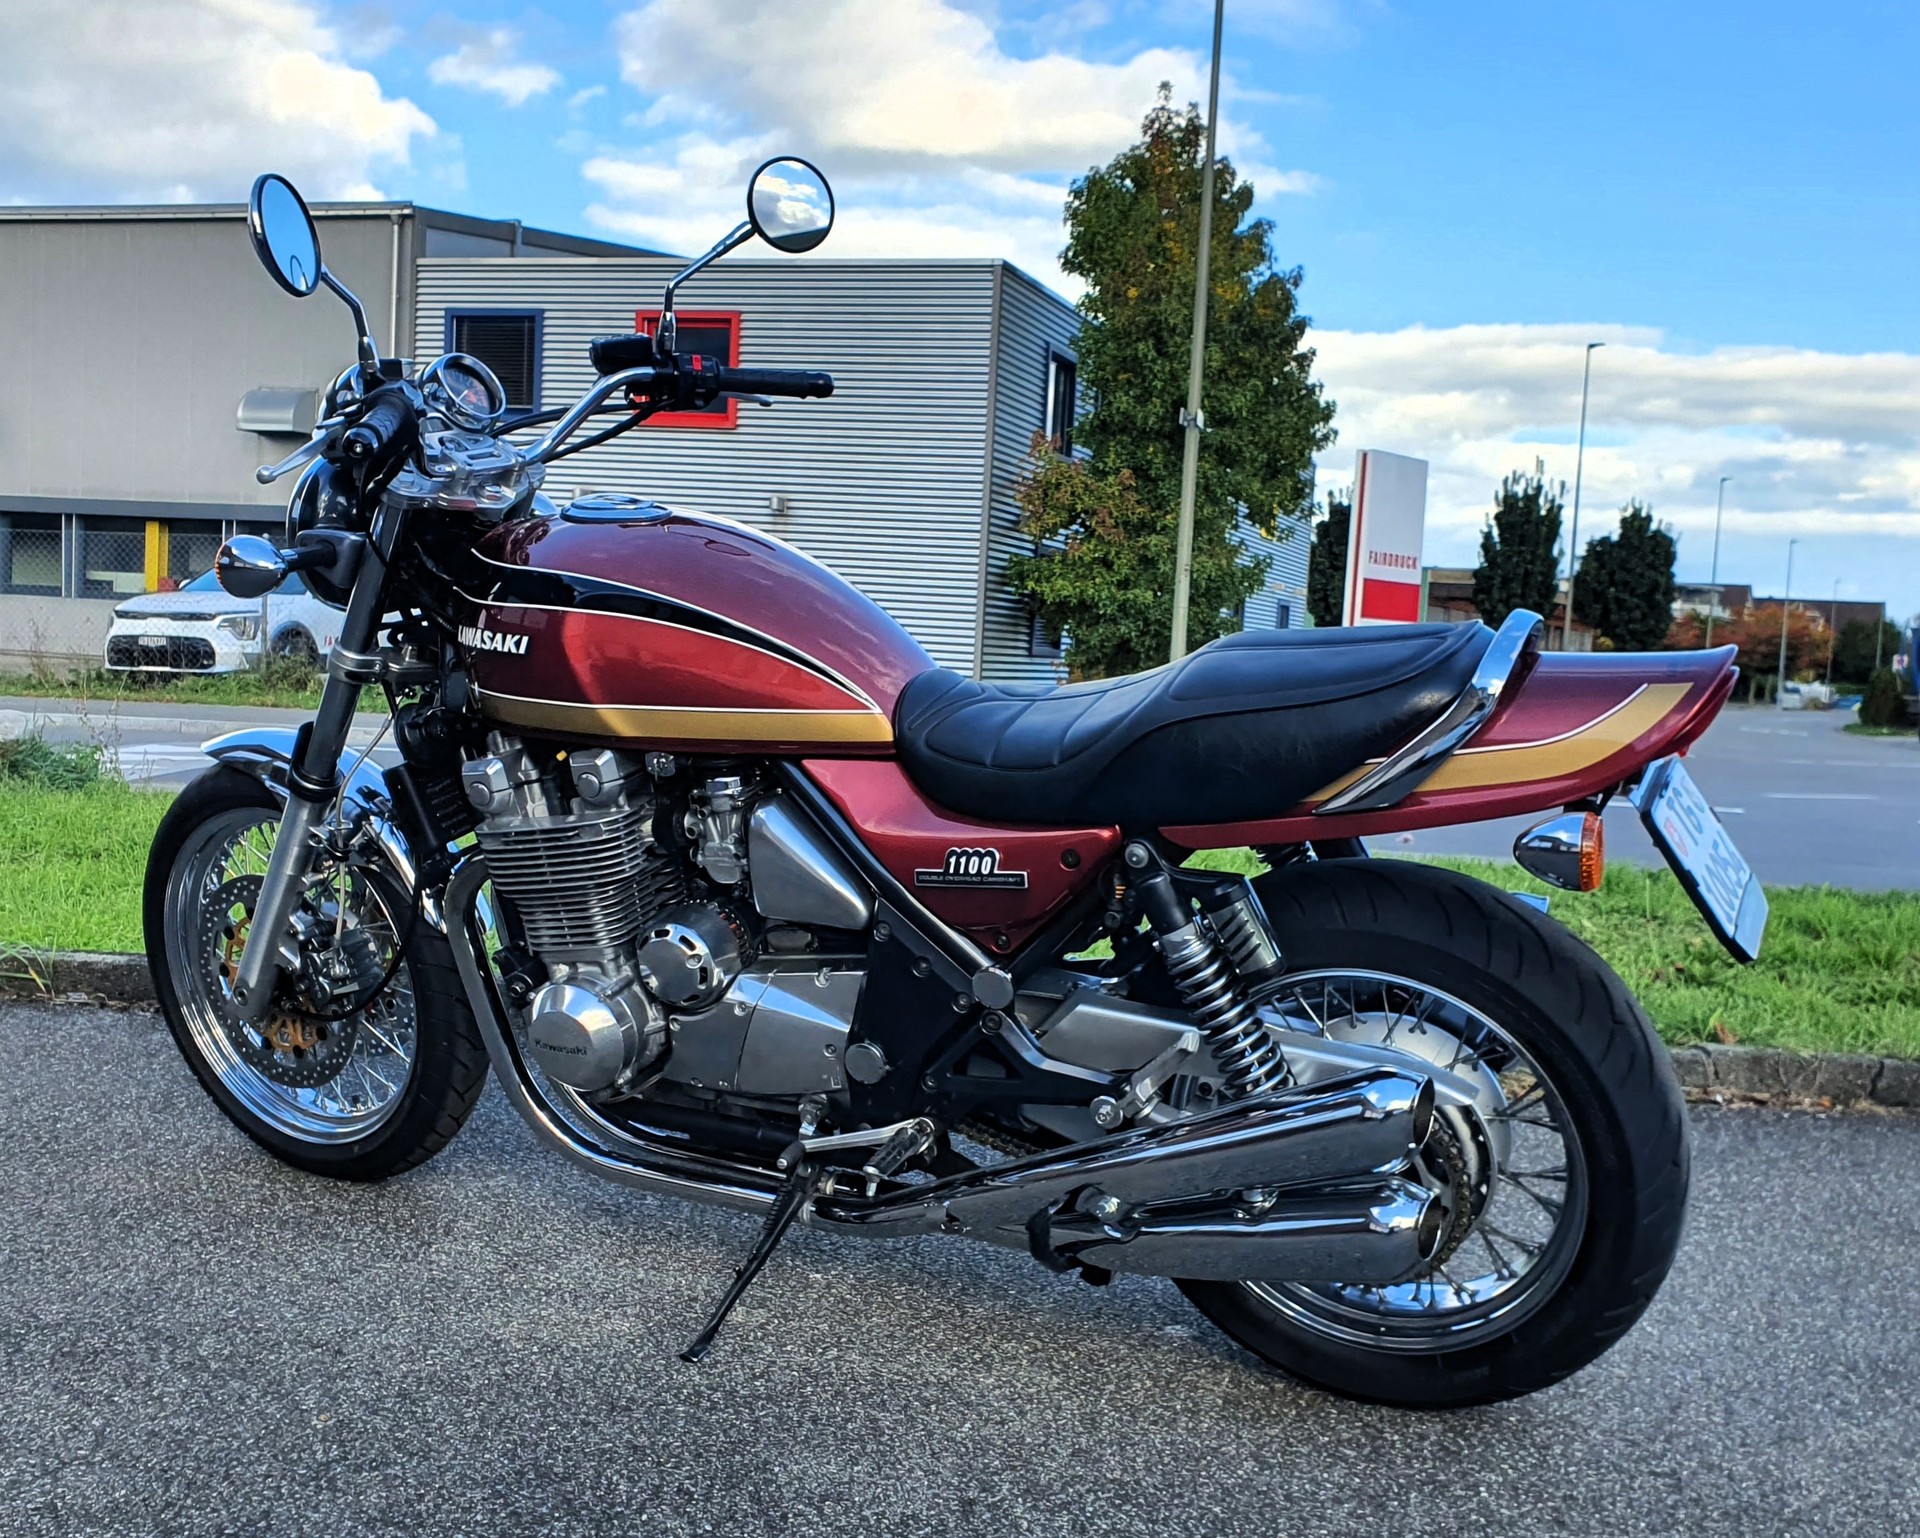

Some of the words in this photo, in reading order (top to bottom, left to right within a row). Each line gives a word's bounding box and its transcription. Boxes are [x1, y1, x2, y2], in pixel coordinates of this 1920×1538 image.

[1368, 550, 1418, 570] FAIRDRUCK
[1666, 786, 1704, 847] TG
[948, 855, 993, 875] 1100
[1700, 830, 1748, 927] 10054
[534, 1039, 588, 1056] Kawasaki
